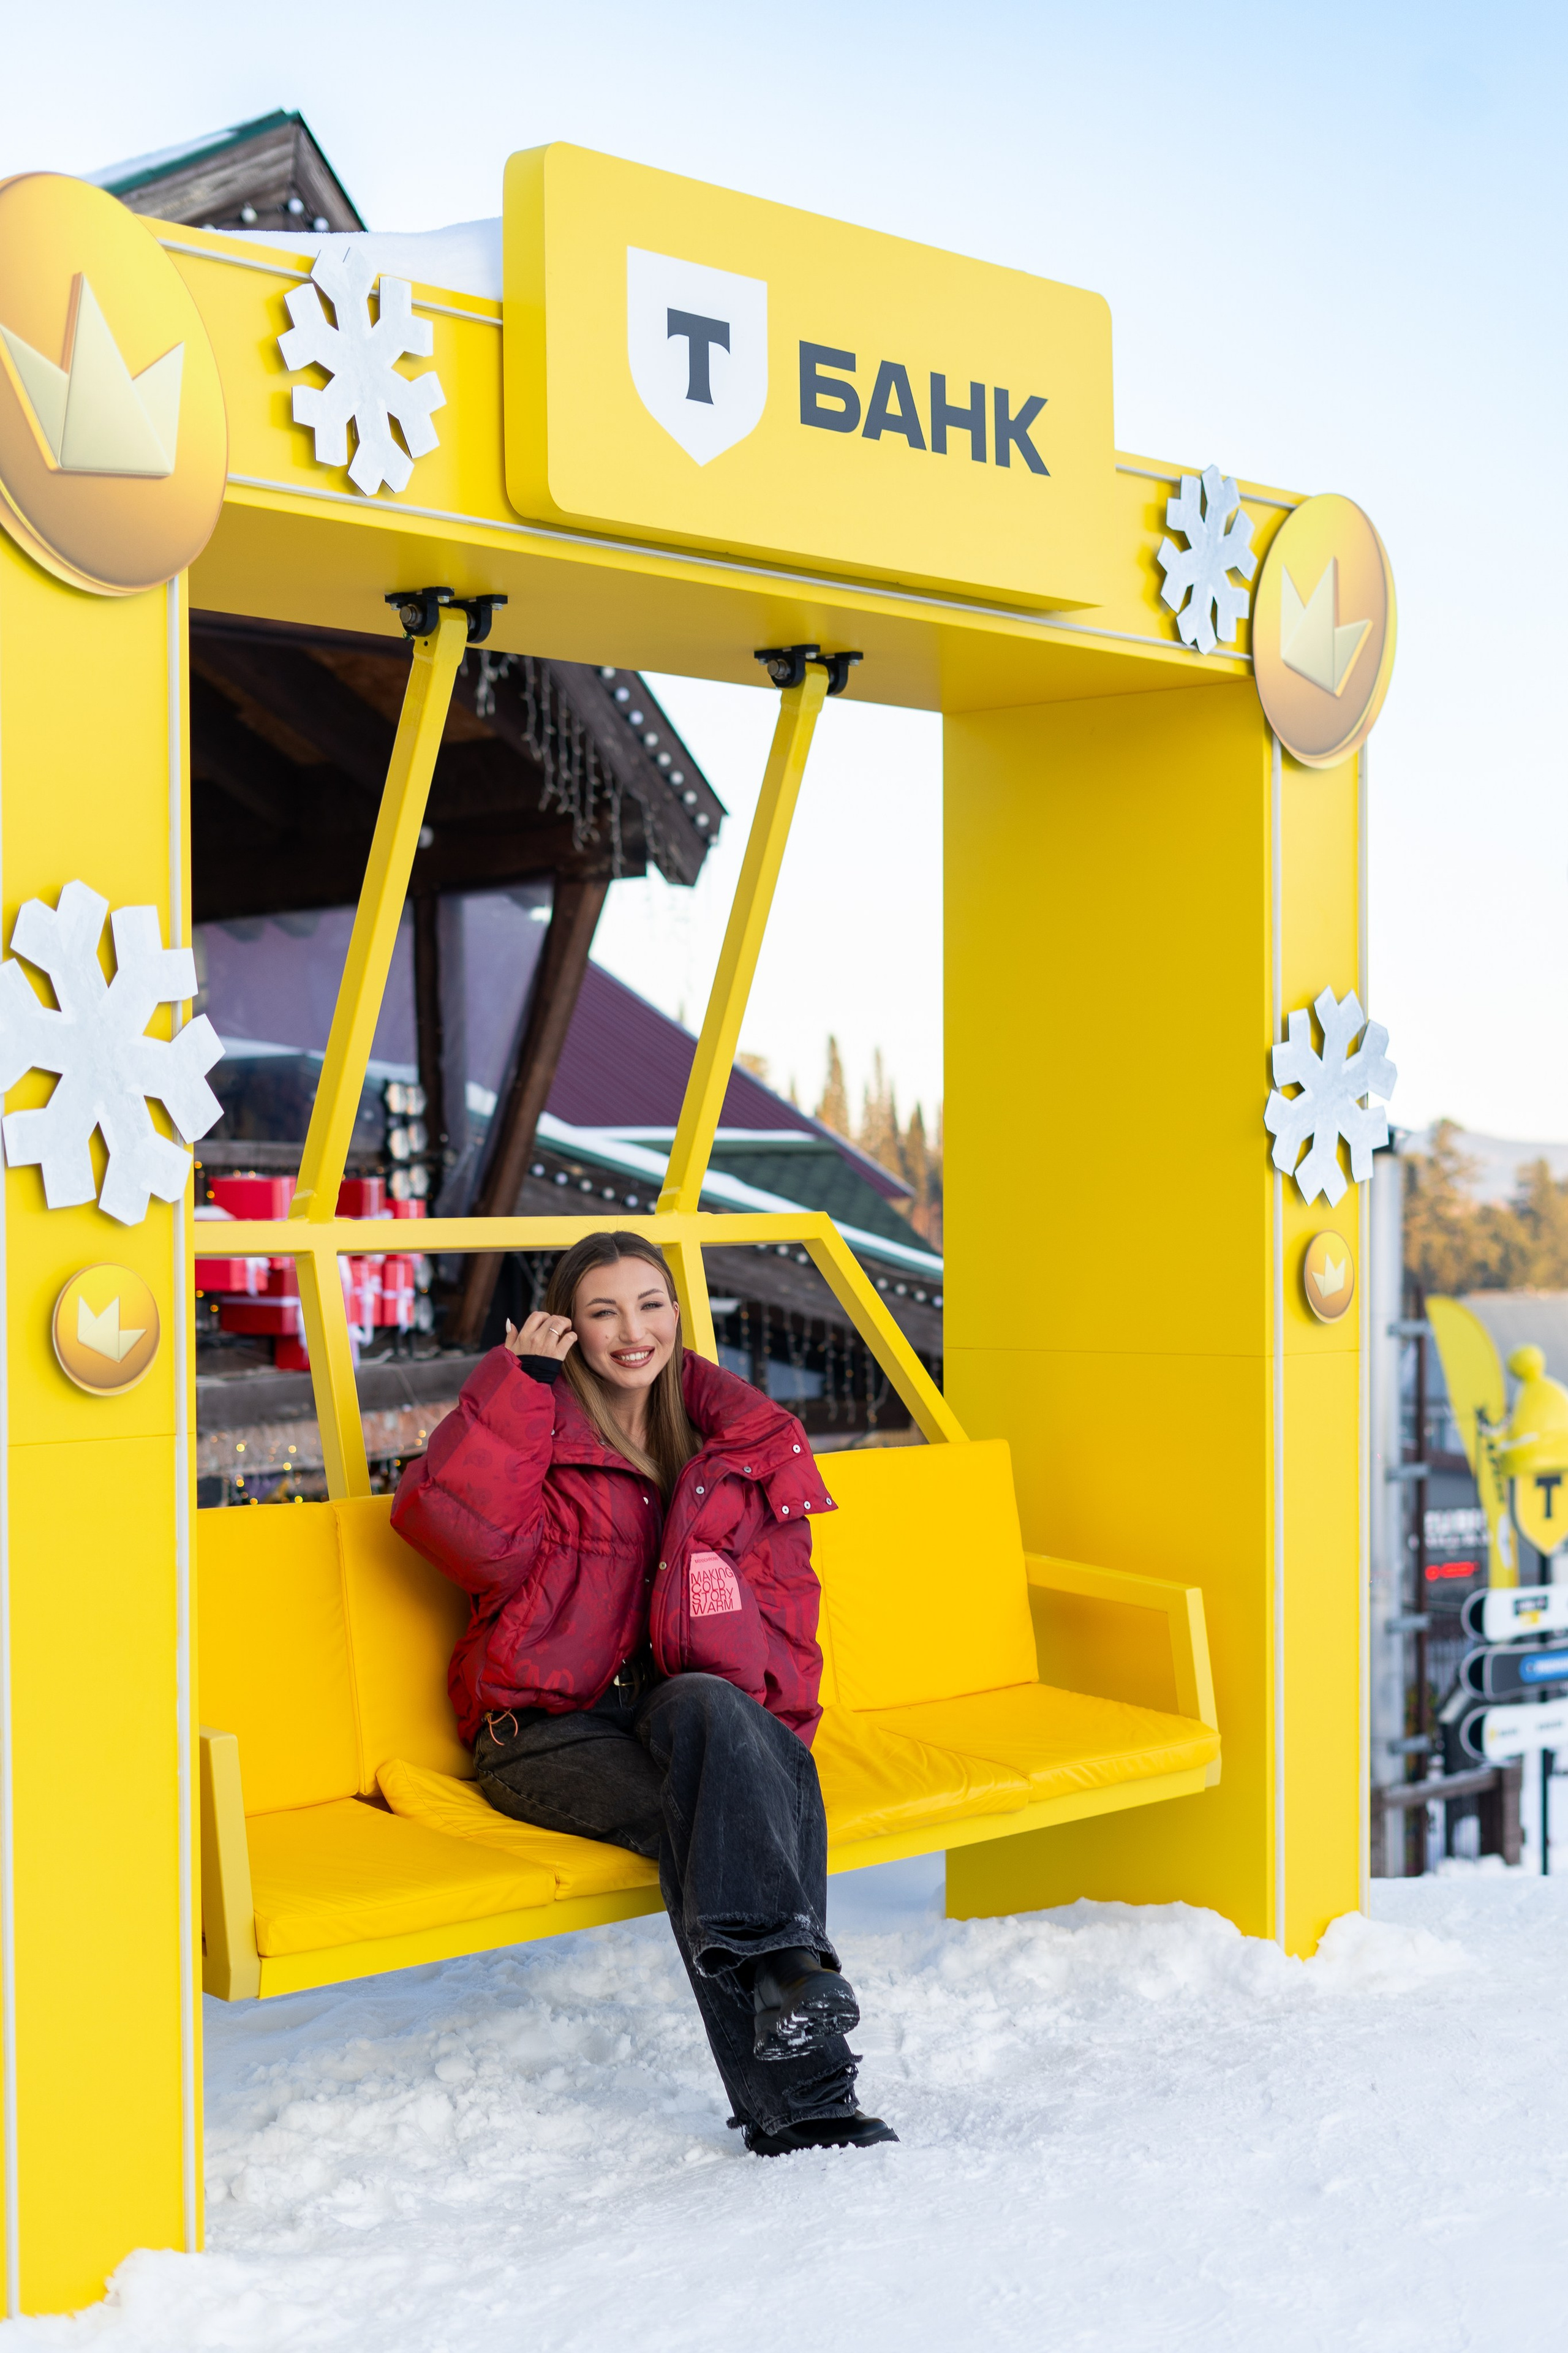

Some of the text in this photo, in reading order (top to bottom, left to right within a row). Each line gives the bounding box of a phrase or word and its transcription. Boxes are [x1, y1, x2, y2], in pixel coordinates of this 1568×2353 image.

[667, 308, 1051, 477] Т БАНК
[1536, 1476, 1562, 1519] Т
[691, 1567, 734, 1584] MAKING
[692, 1579, 725, 1594] COLD
[692, 1587, 733, 1604] STORY
[692, 1598, 733, 1615] WARM
